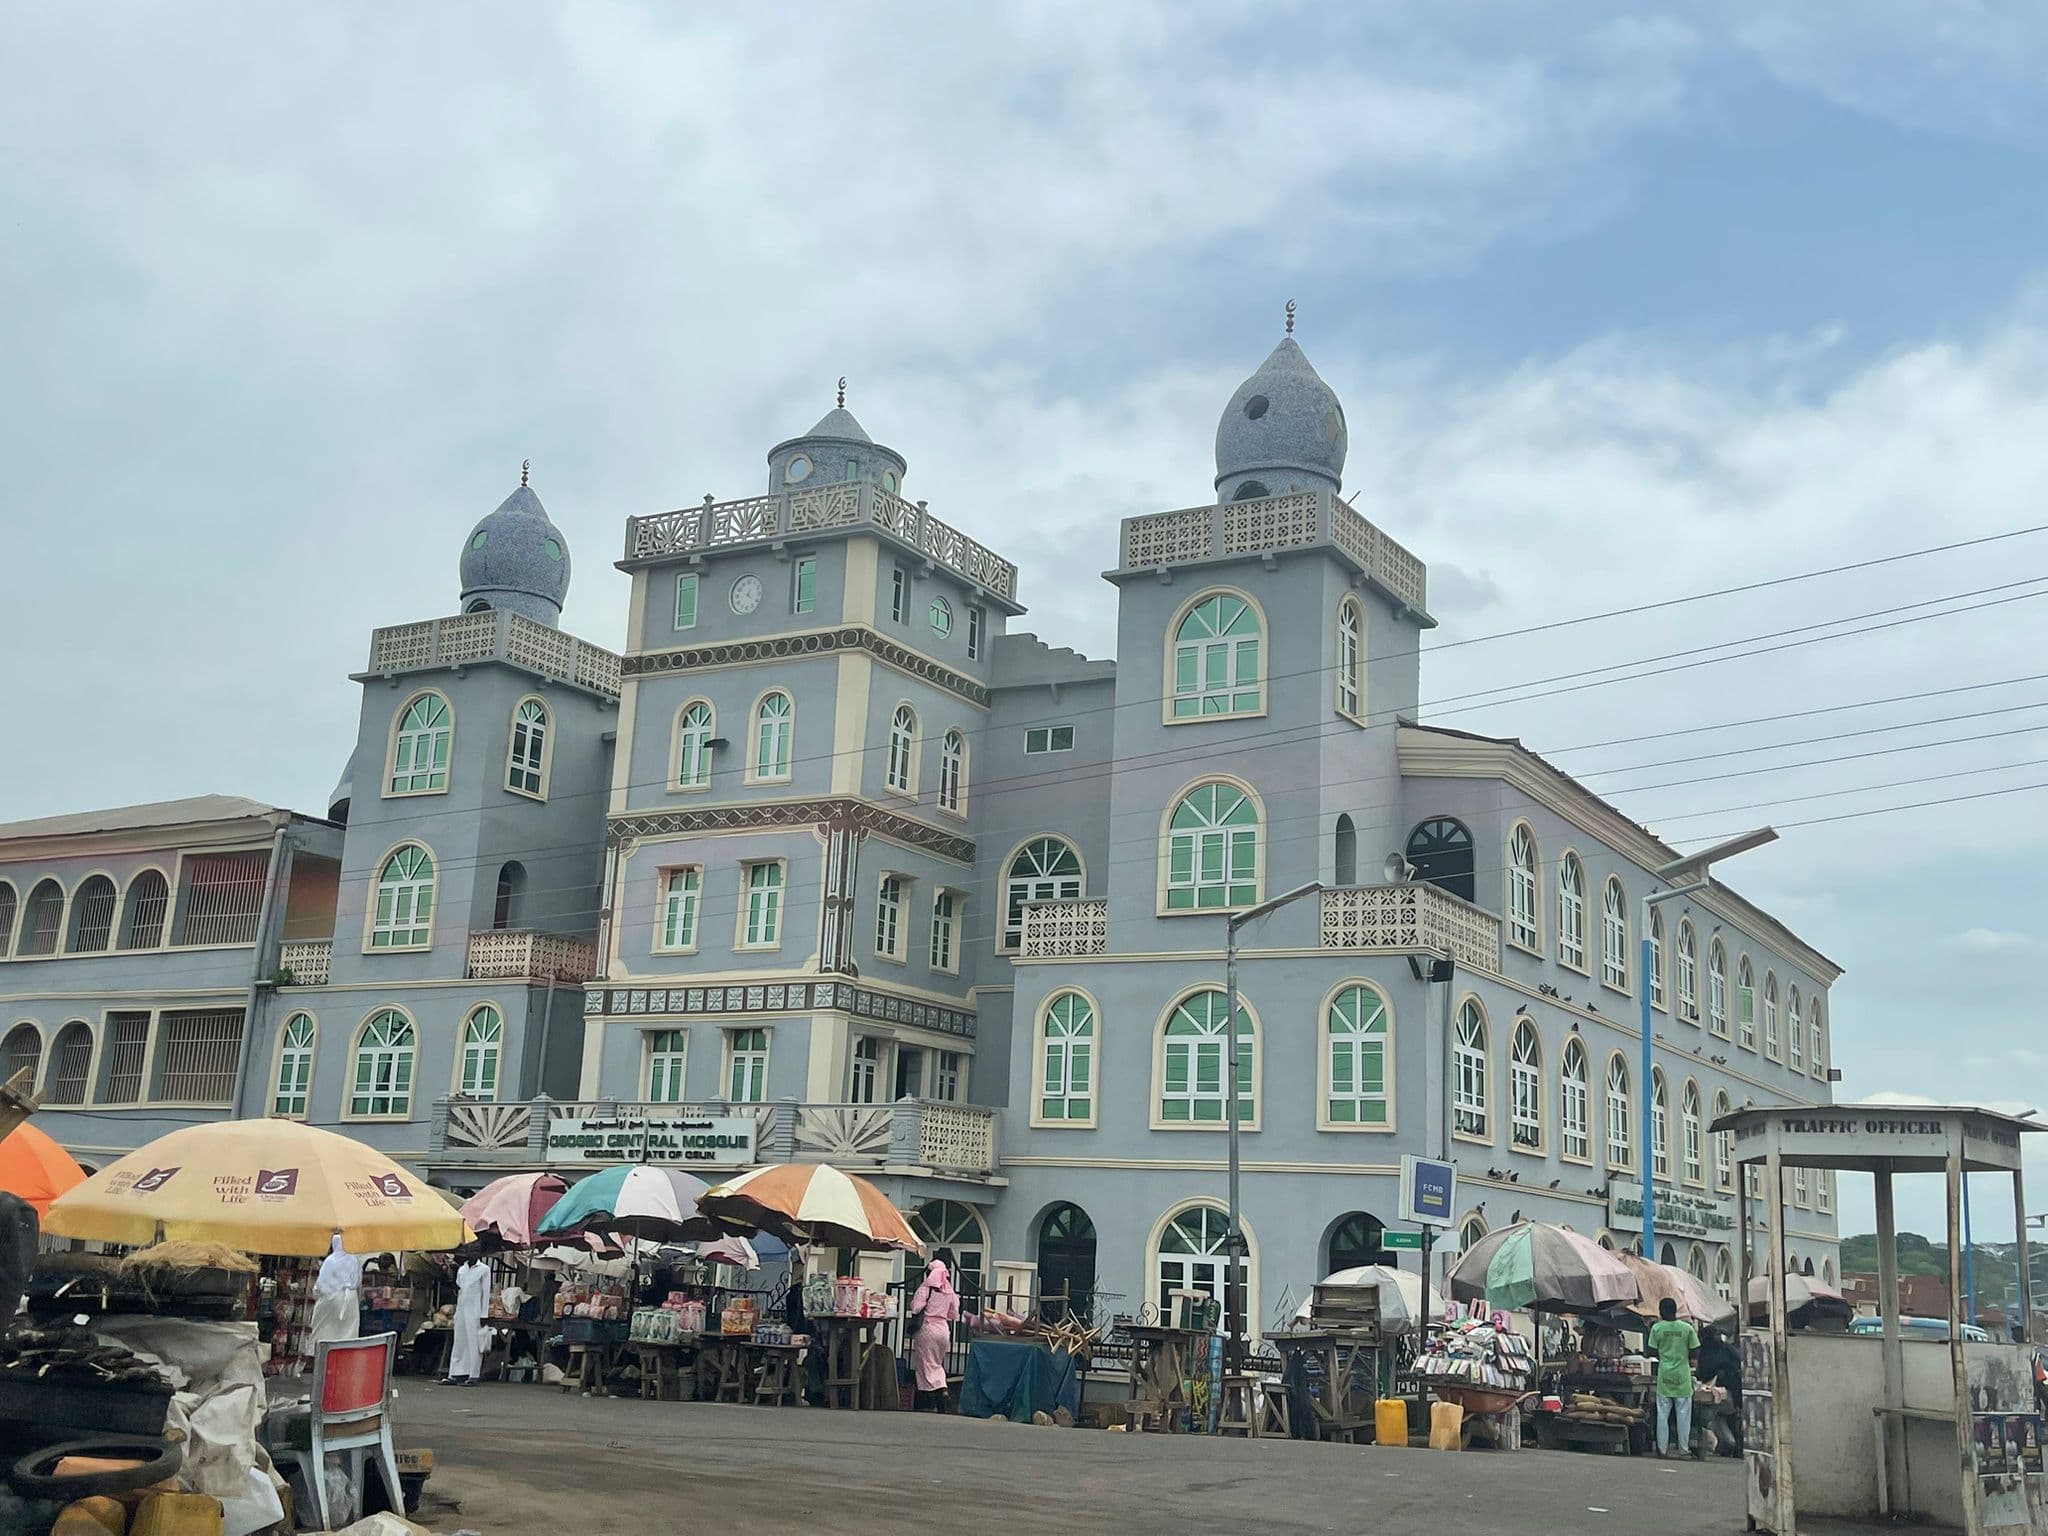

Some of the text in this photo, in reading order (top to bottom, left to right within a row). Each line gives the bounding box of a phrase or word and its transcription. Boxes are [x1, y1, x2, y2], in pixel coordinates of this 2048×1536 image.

[1782, 1119, 1857, 1134] TRAFFIC
[1865, 1120, 1942, 1135] OFFICER
[549, 1134, 749, 1149] OSOGBO CENTRAL MOSQUE
[668, 1150, 683, 1160] OF
[213, 1176, 252, 1185] Filled
[215, 1185, 249, 1194] with
[1422, 1183, 1444, 1194] FCMB
[221, 1194, 247, 1203] Life
